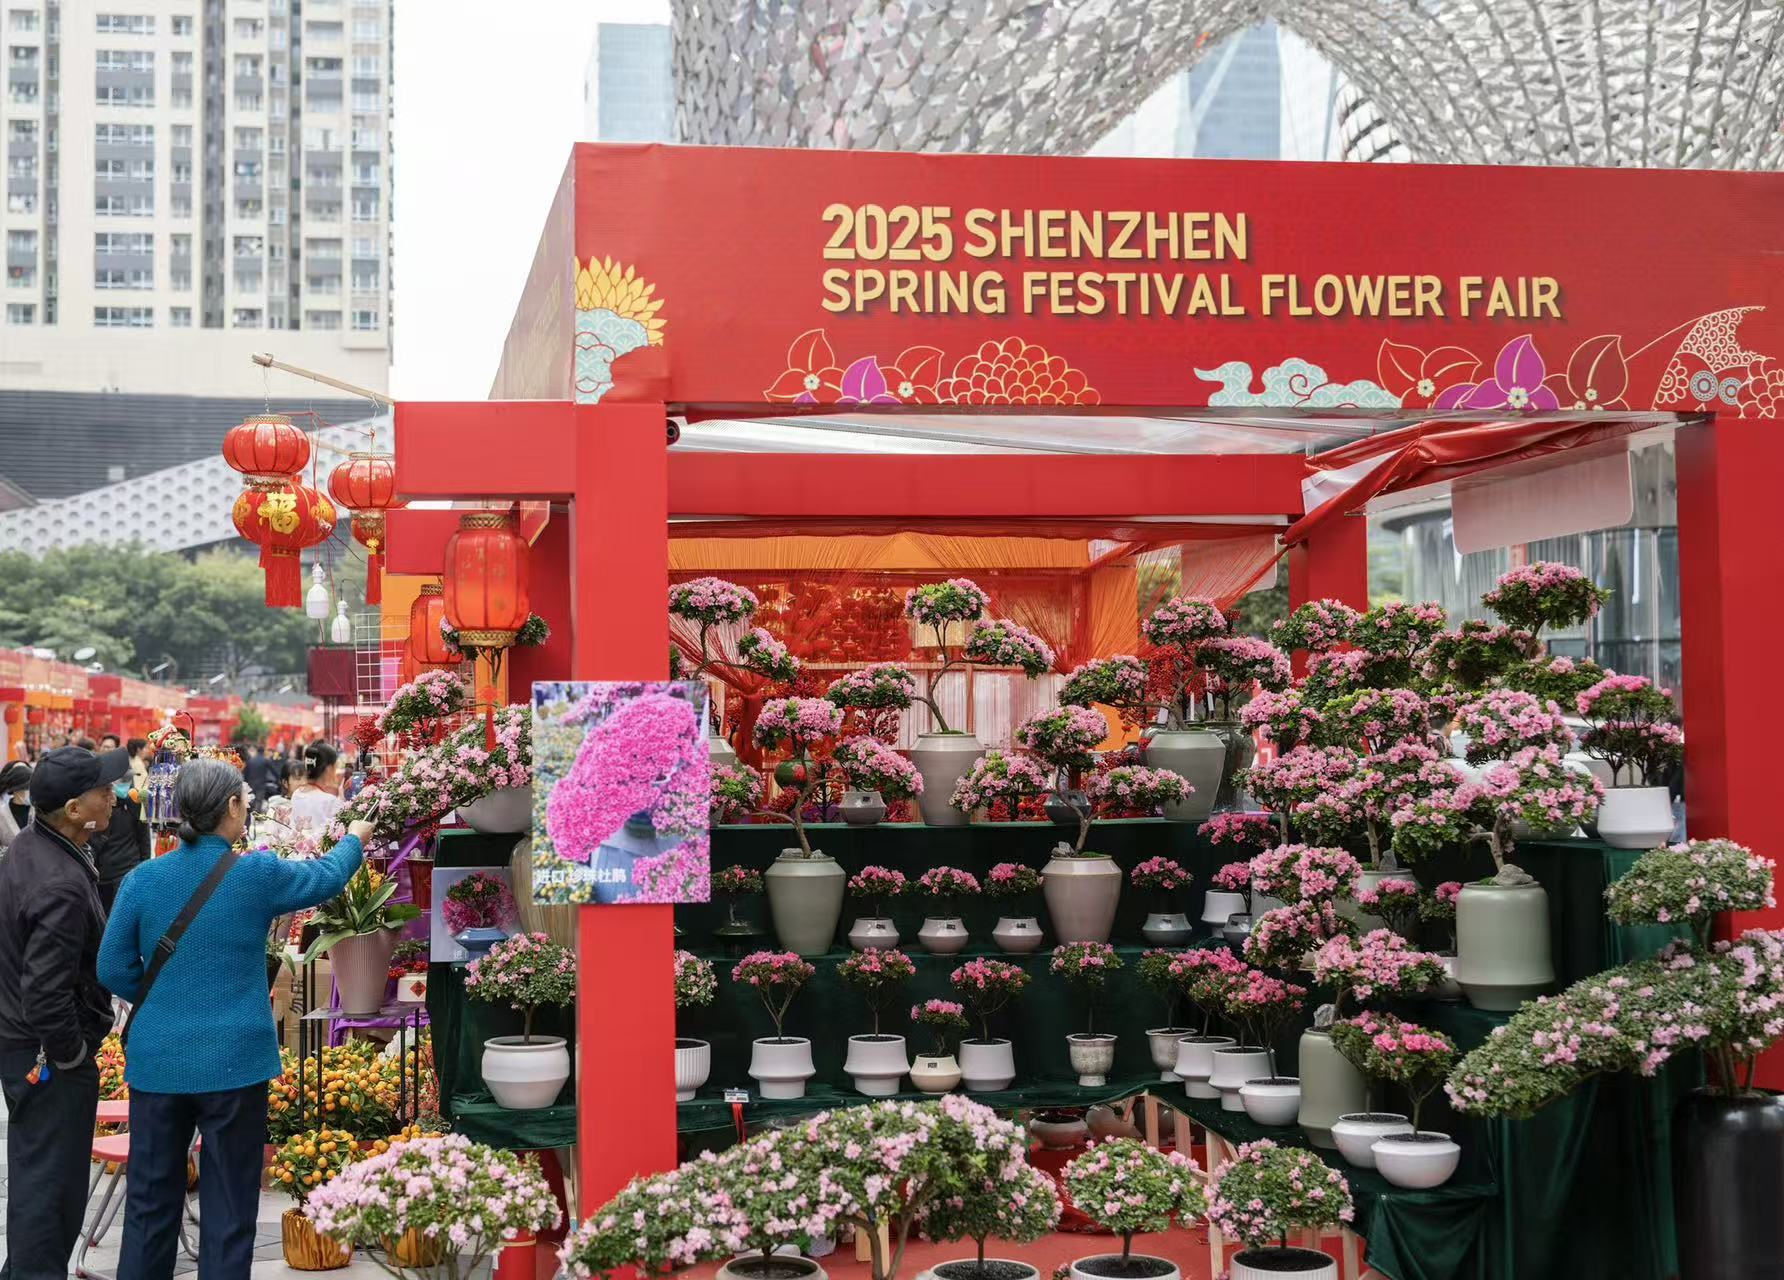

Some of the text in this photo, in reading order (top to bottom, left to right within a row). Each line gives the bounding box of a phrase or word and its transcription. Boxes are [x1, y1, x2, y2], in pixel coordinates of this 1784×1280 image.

[821, 204, 1248, 260] 2025 SHENZHEN
[821, 267, 1561, 318] SPRING FESTIVAL FLOWER FAIR
[257, 492, 301, 535] 福
